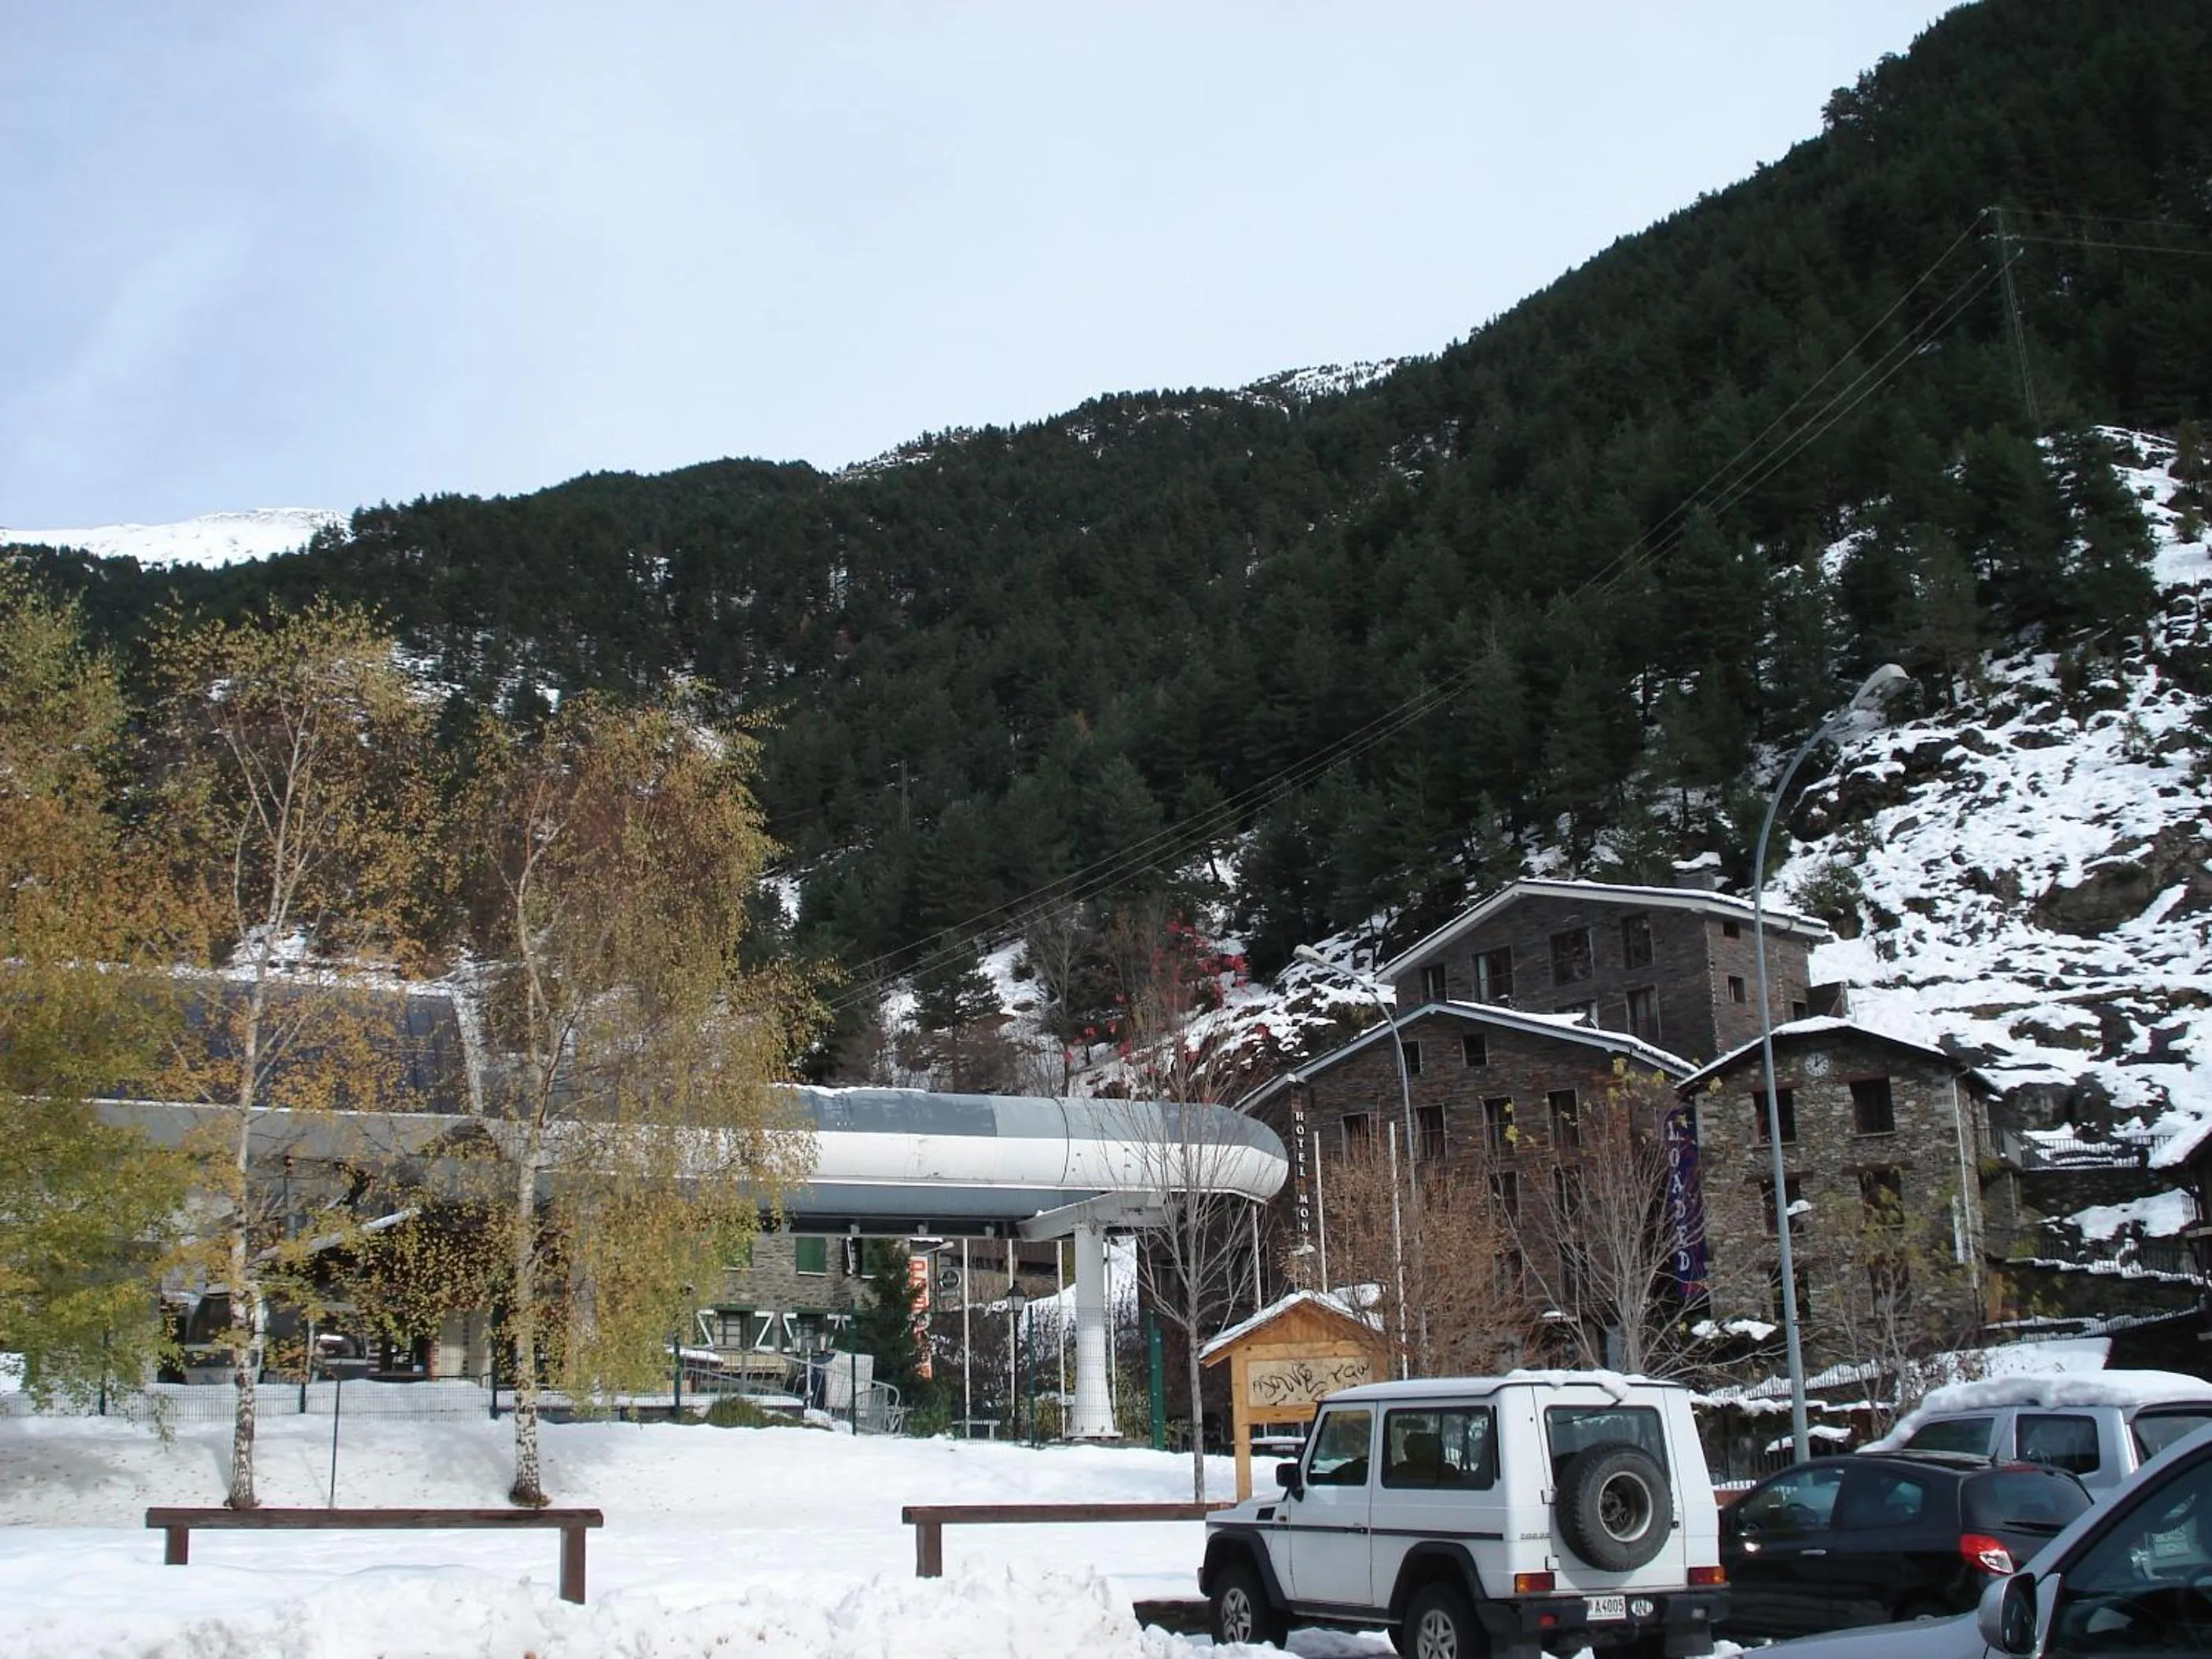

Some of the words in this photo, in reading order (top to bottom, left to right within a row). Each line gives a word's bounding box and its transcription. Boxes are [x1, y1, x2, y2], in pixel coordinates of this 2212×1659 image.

[1295, 1111, 1306, 1177] HOTEL
[1668, 1120, 1690, 1271] LOADED
[1595, 1599, 1624, 1613] A4005
